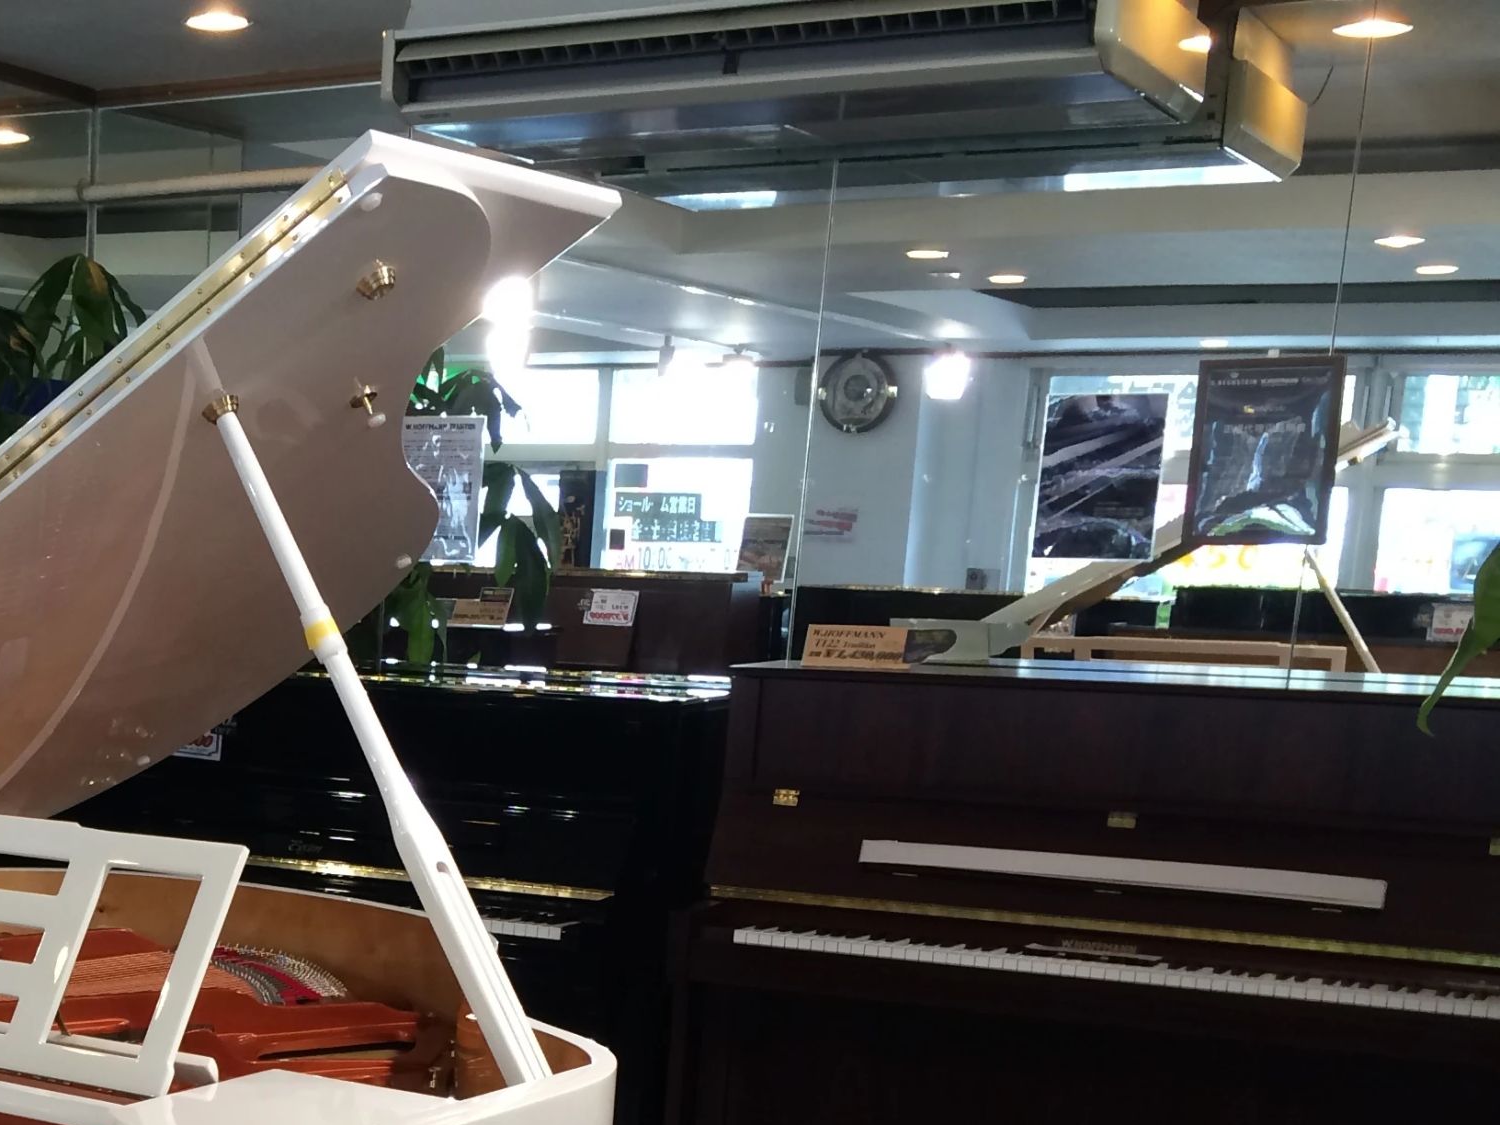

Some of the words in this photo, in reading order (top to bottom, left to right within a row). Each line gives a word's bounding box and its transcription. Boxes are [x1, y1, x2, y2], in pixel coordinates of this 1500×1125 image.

[618, 495, 696, 514] ショールム営業日
